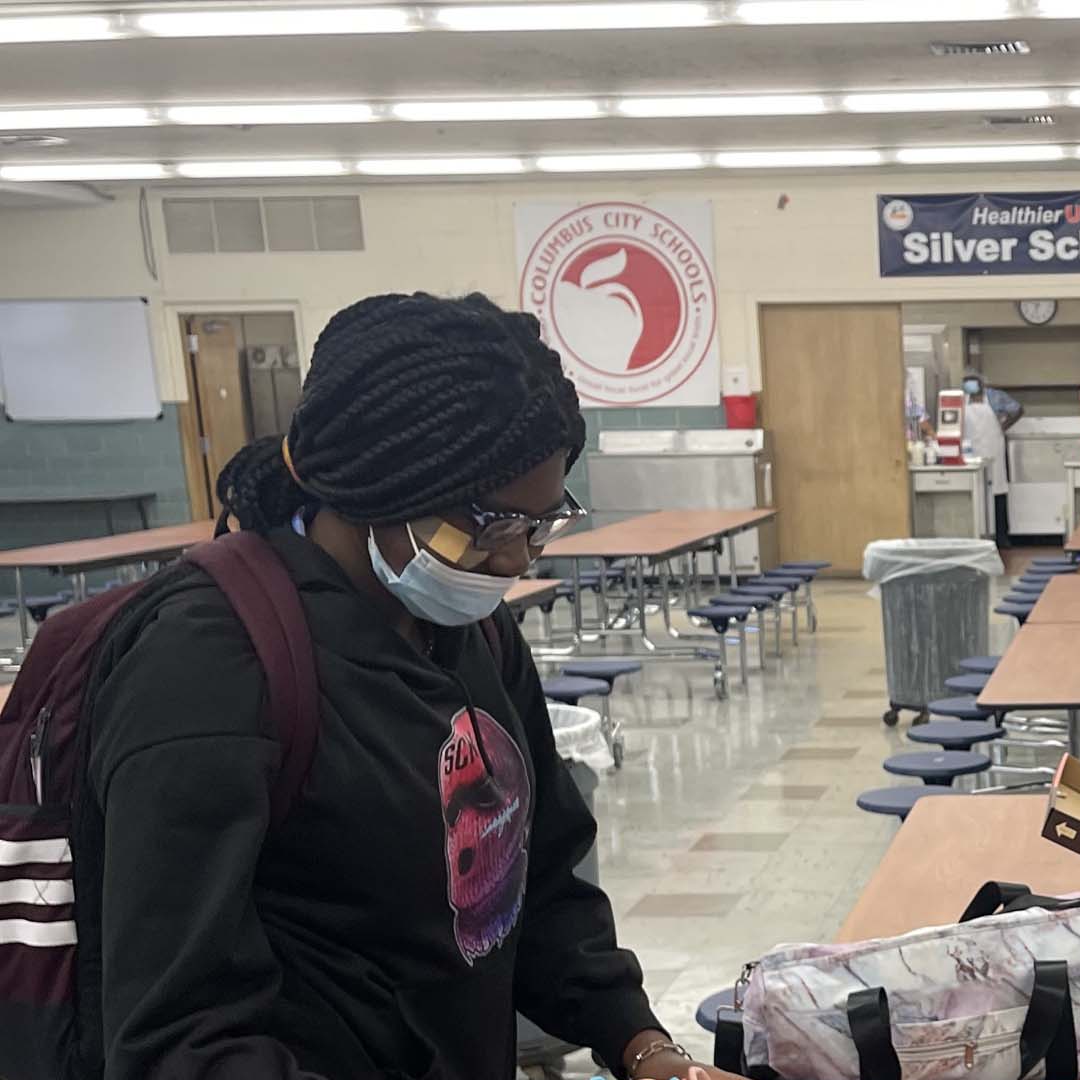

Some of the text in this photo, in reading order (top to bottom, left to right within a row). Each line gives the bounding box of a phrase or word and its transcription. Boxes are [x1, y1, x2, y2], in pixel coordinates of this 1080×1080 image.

[531, 211, 707, 306] COLUMBUS CITY SCHOOLS
[903, 230, 1018, 264] Silver
